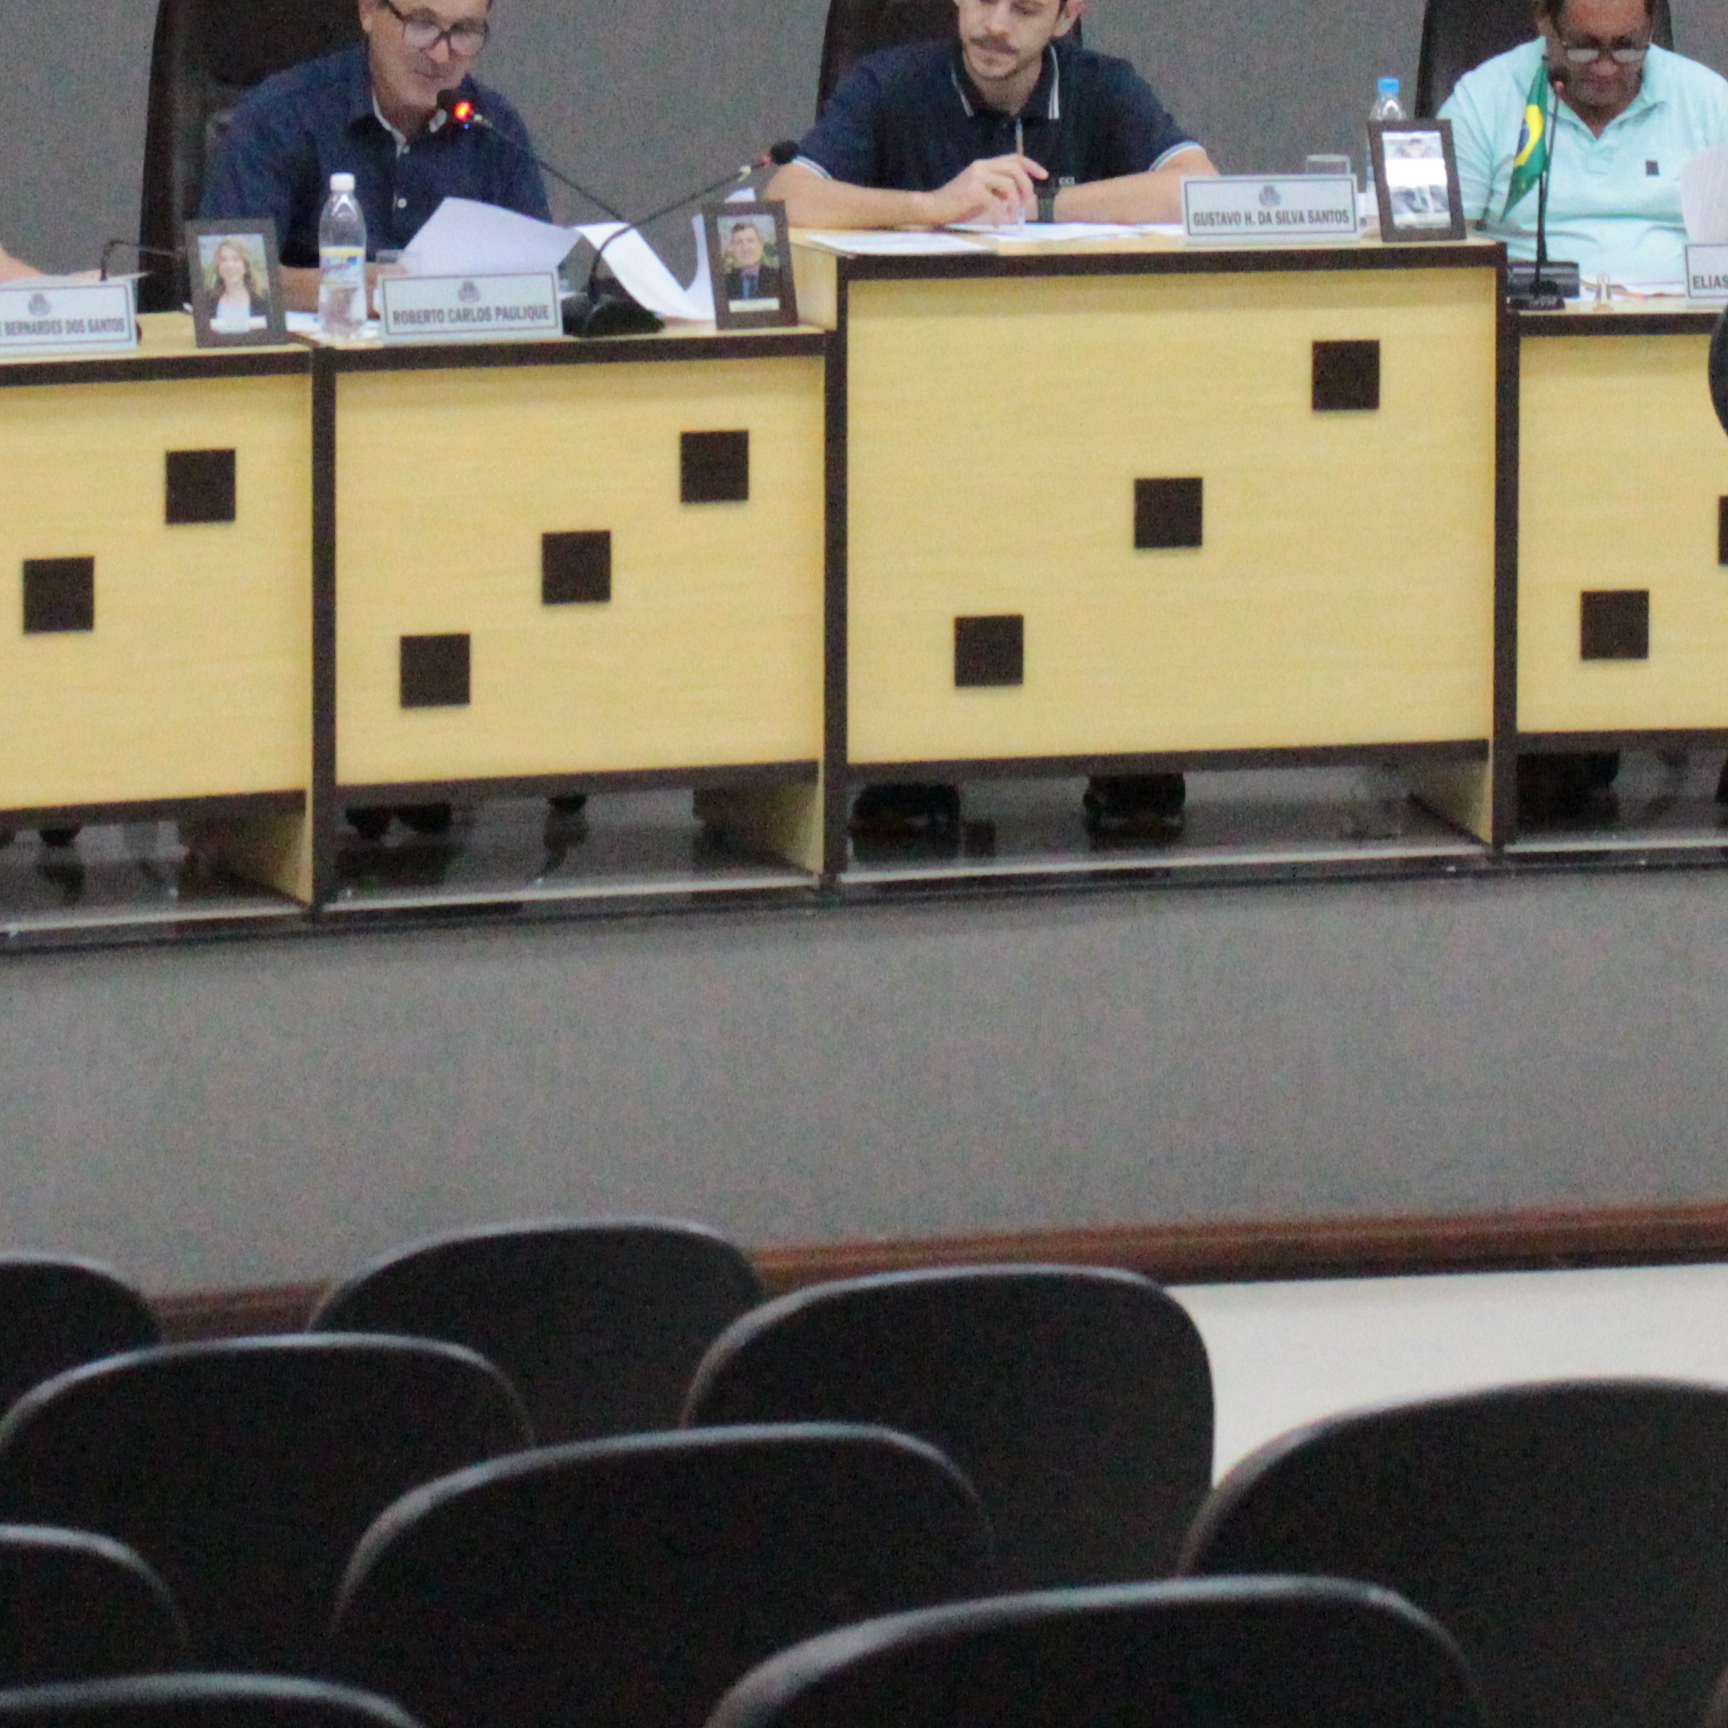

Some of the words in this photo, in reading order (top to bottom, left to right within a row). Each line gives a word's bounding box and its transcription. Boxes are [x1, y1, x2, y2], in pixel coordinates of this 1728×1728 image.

[1193, 211, 1241, 227] GUSTAVO
[1245, 210, 1255, 225] H.
[1258, 210, 1272, 225] DA
[1275, 209, 1304, 224] SILVA
[1308, 208, 1349, 224] SANTOS
[393, 308, 445, 325] ROBERTO
[448, 306, 492, 323] CARLOS
[495, 304, 549, 320] PAULIQUE
[65, 319, 85, 334] DOS
[88, 318, 125, 333] SANTOS
